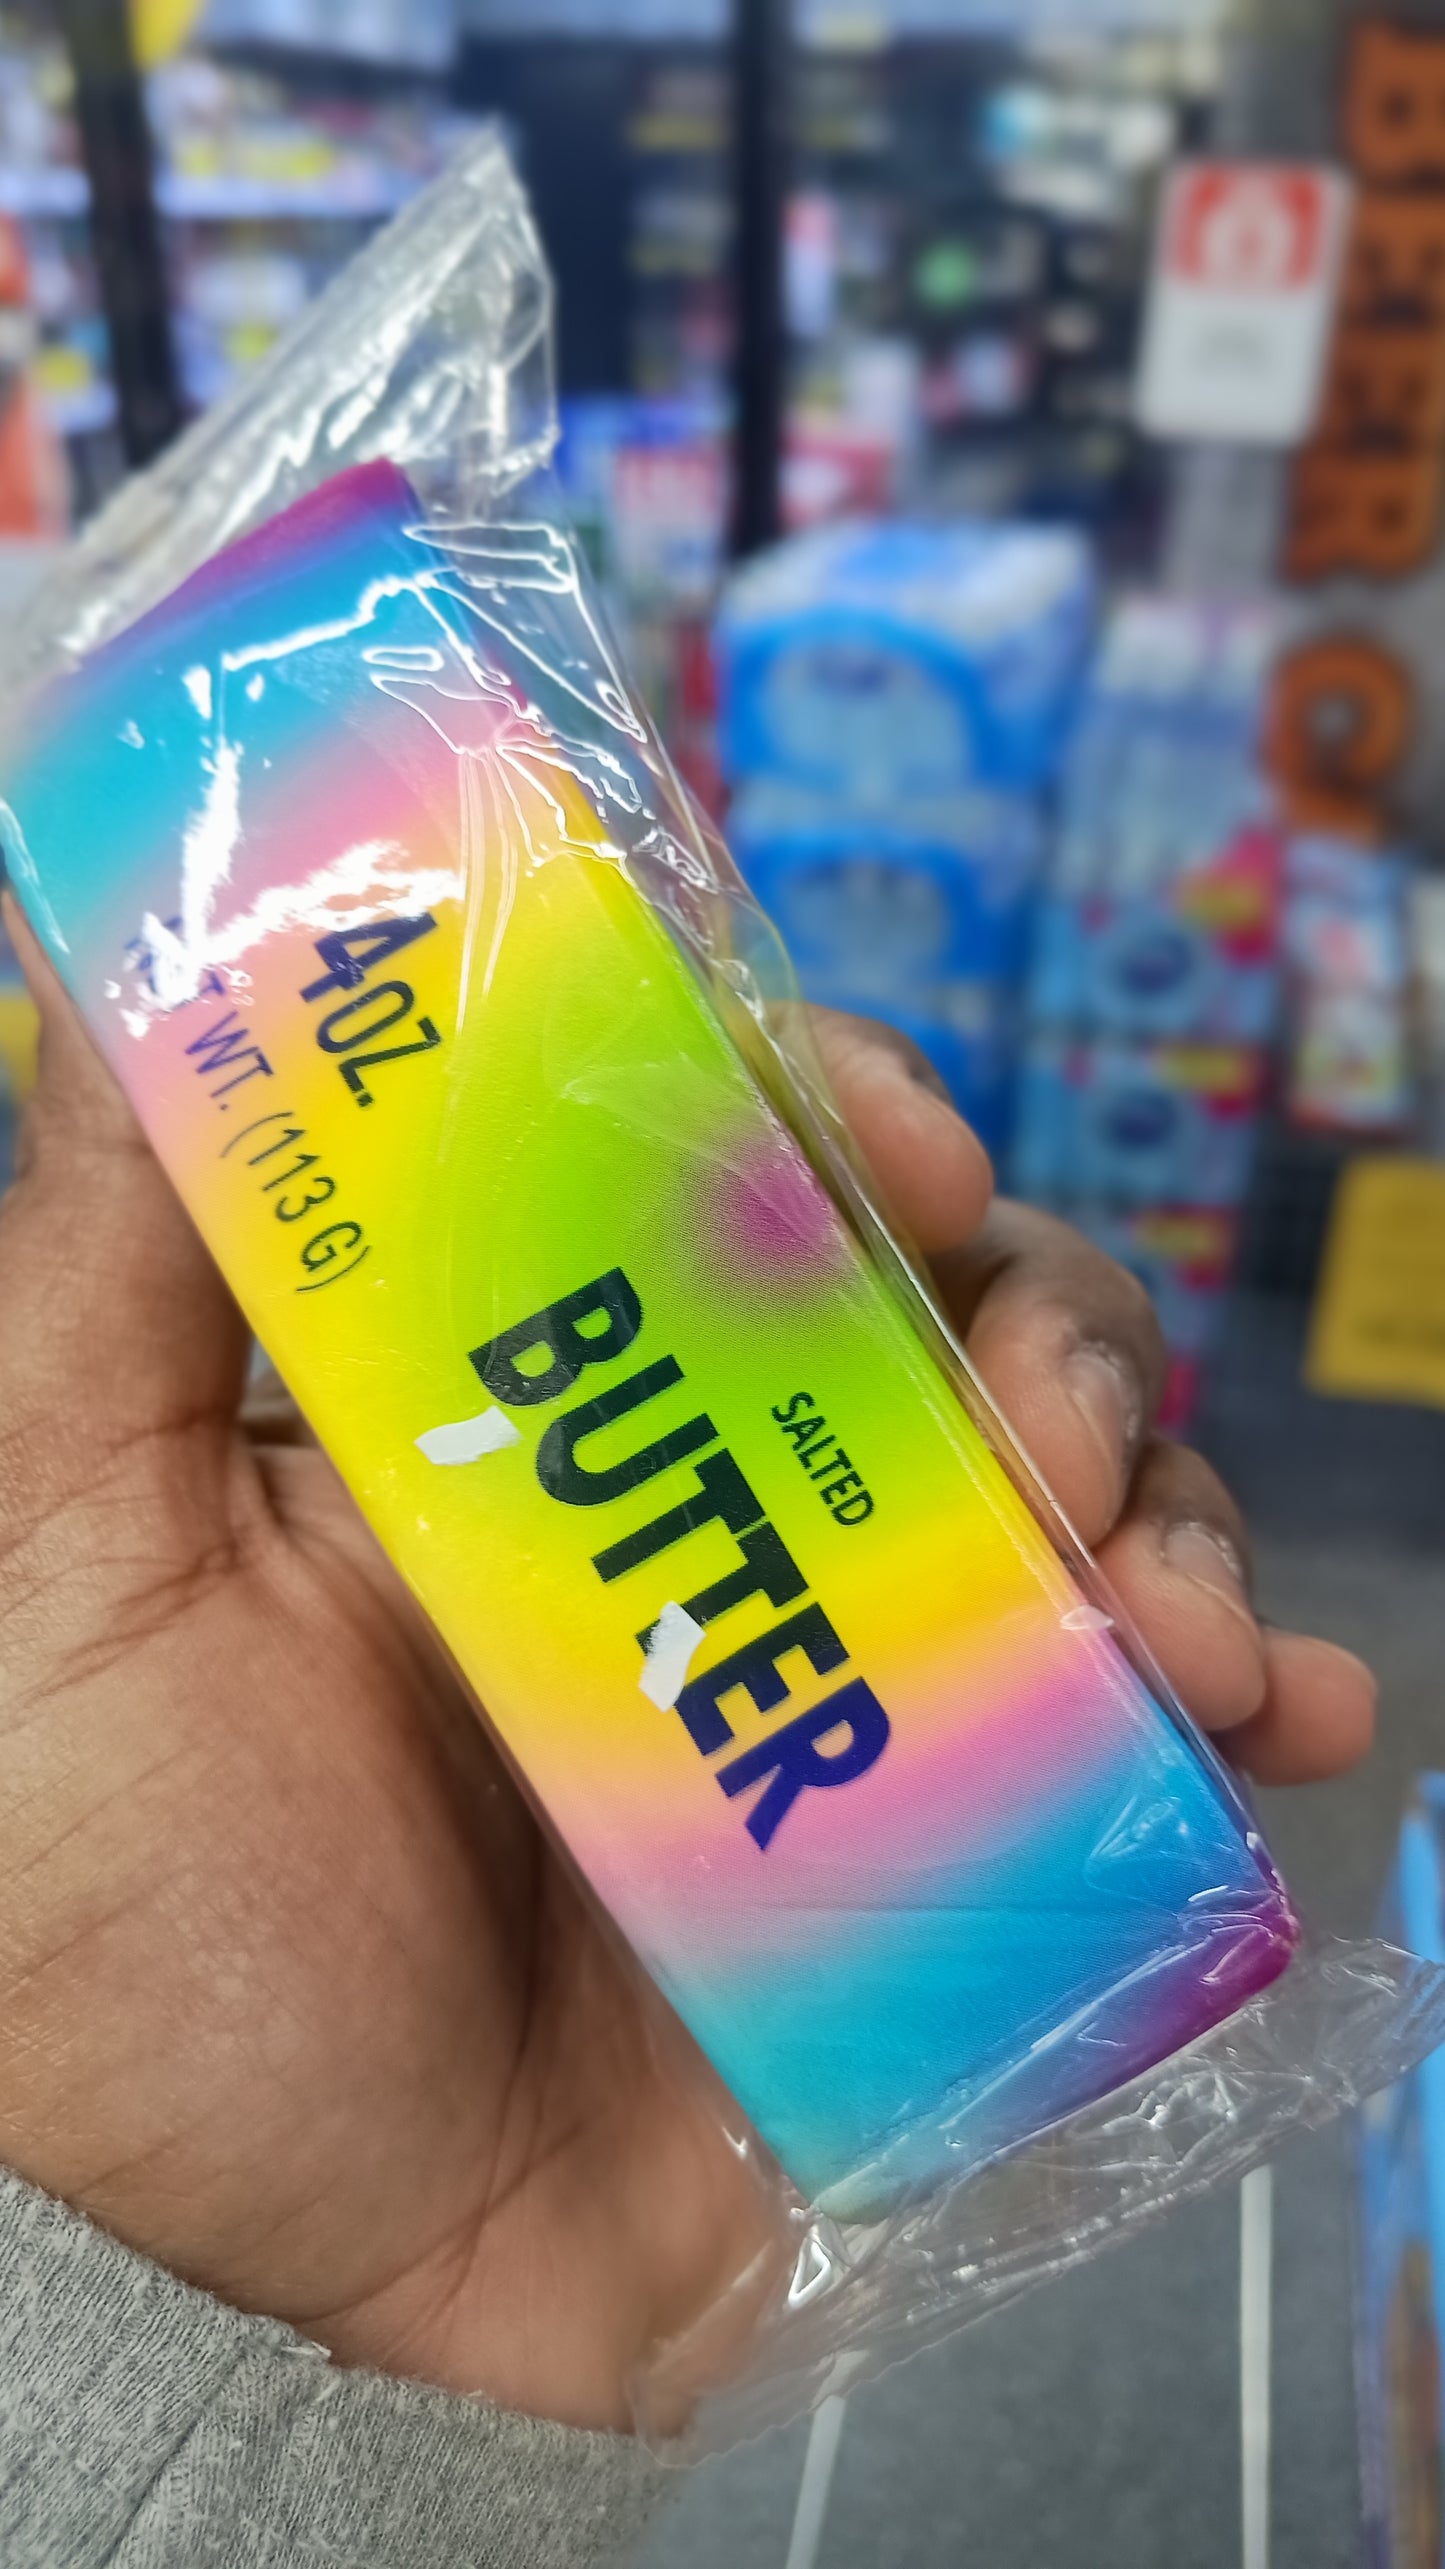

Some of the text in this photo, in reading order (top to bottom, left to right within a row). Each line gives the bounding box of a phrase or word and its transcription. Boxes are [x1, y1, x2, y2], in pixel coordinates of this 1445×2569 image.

[185, 1010, 274, 1112] WT.
[218, 1110, 338, 1224] (113
[295, 1220, 372, 1294] G)
[771, 1391, 876, 1527] SALTED
[467, 1266, 891, 1852] BUTTER
